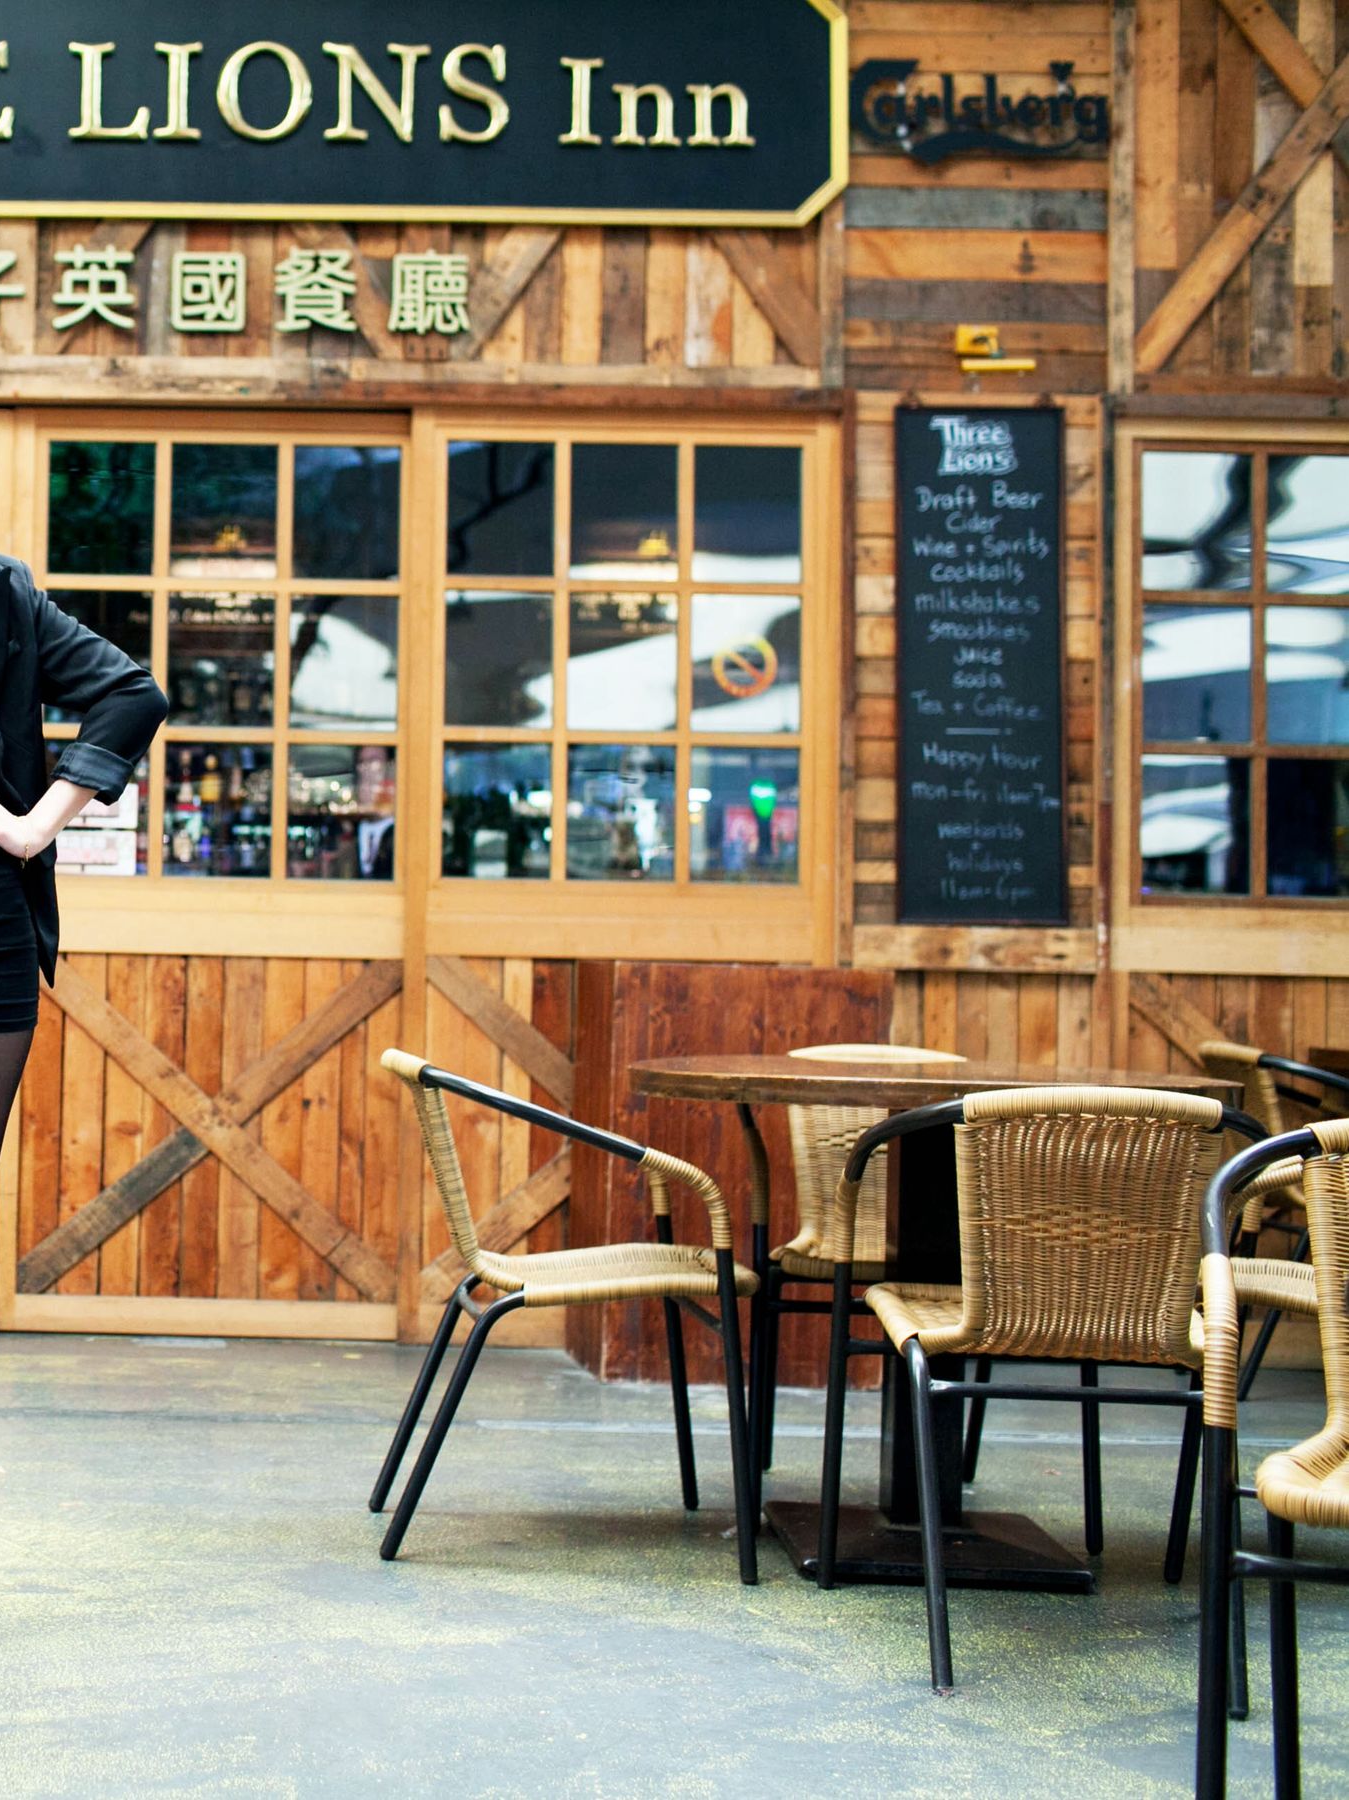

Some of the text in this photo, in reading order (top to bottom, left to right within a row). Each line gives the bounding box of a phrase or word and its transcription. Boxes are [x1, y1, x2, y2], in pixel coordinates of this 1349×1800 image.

[68, 41, 510, 142] LIONS
[558, 57, 756, 147] Inn
[849, 58, 1109, 164] Carlsberg
[930, 415, 1013, 446] Three
[938, 447, 1018, 476] Lions
[915, 480, 1044, 512] Draft Beer
[945, 510, 1003, 534] Cider
[922, 741, 986, 774] Happy
